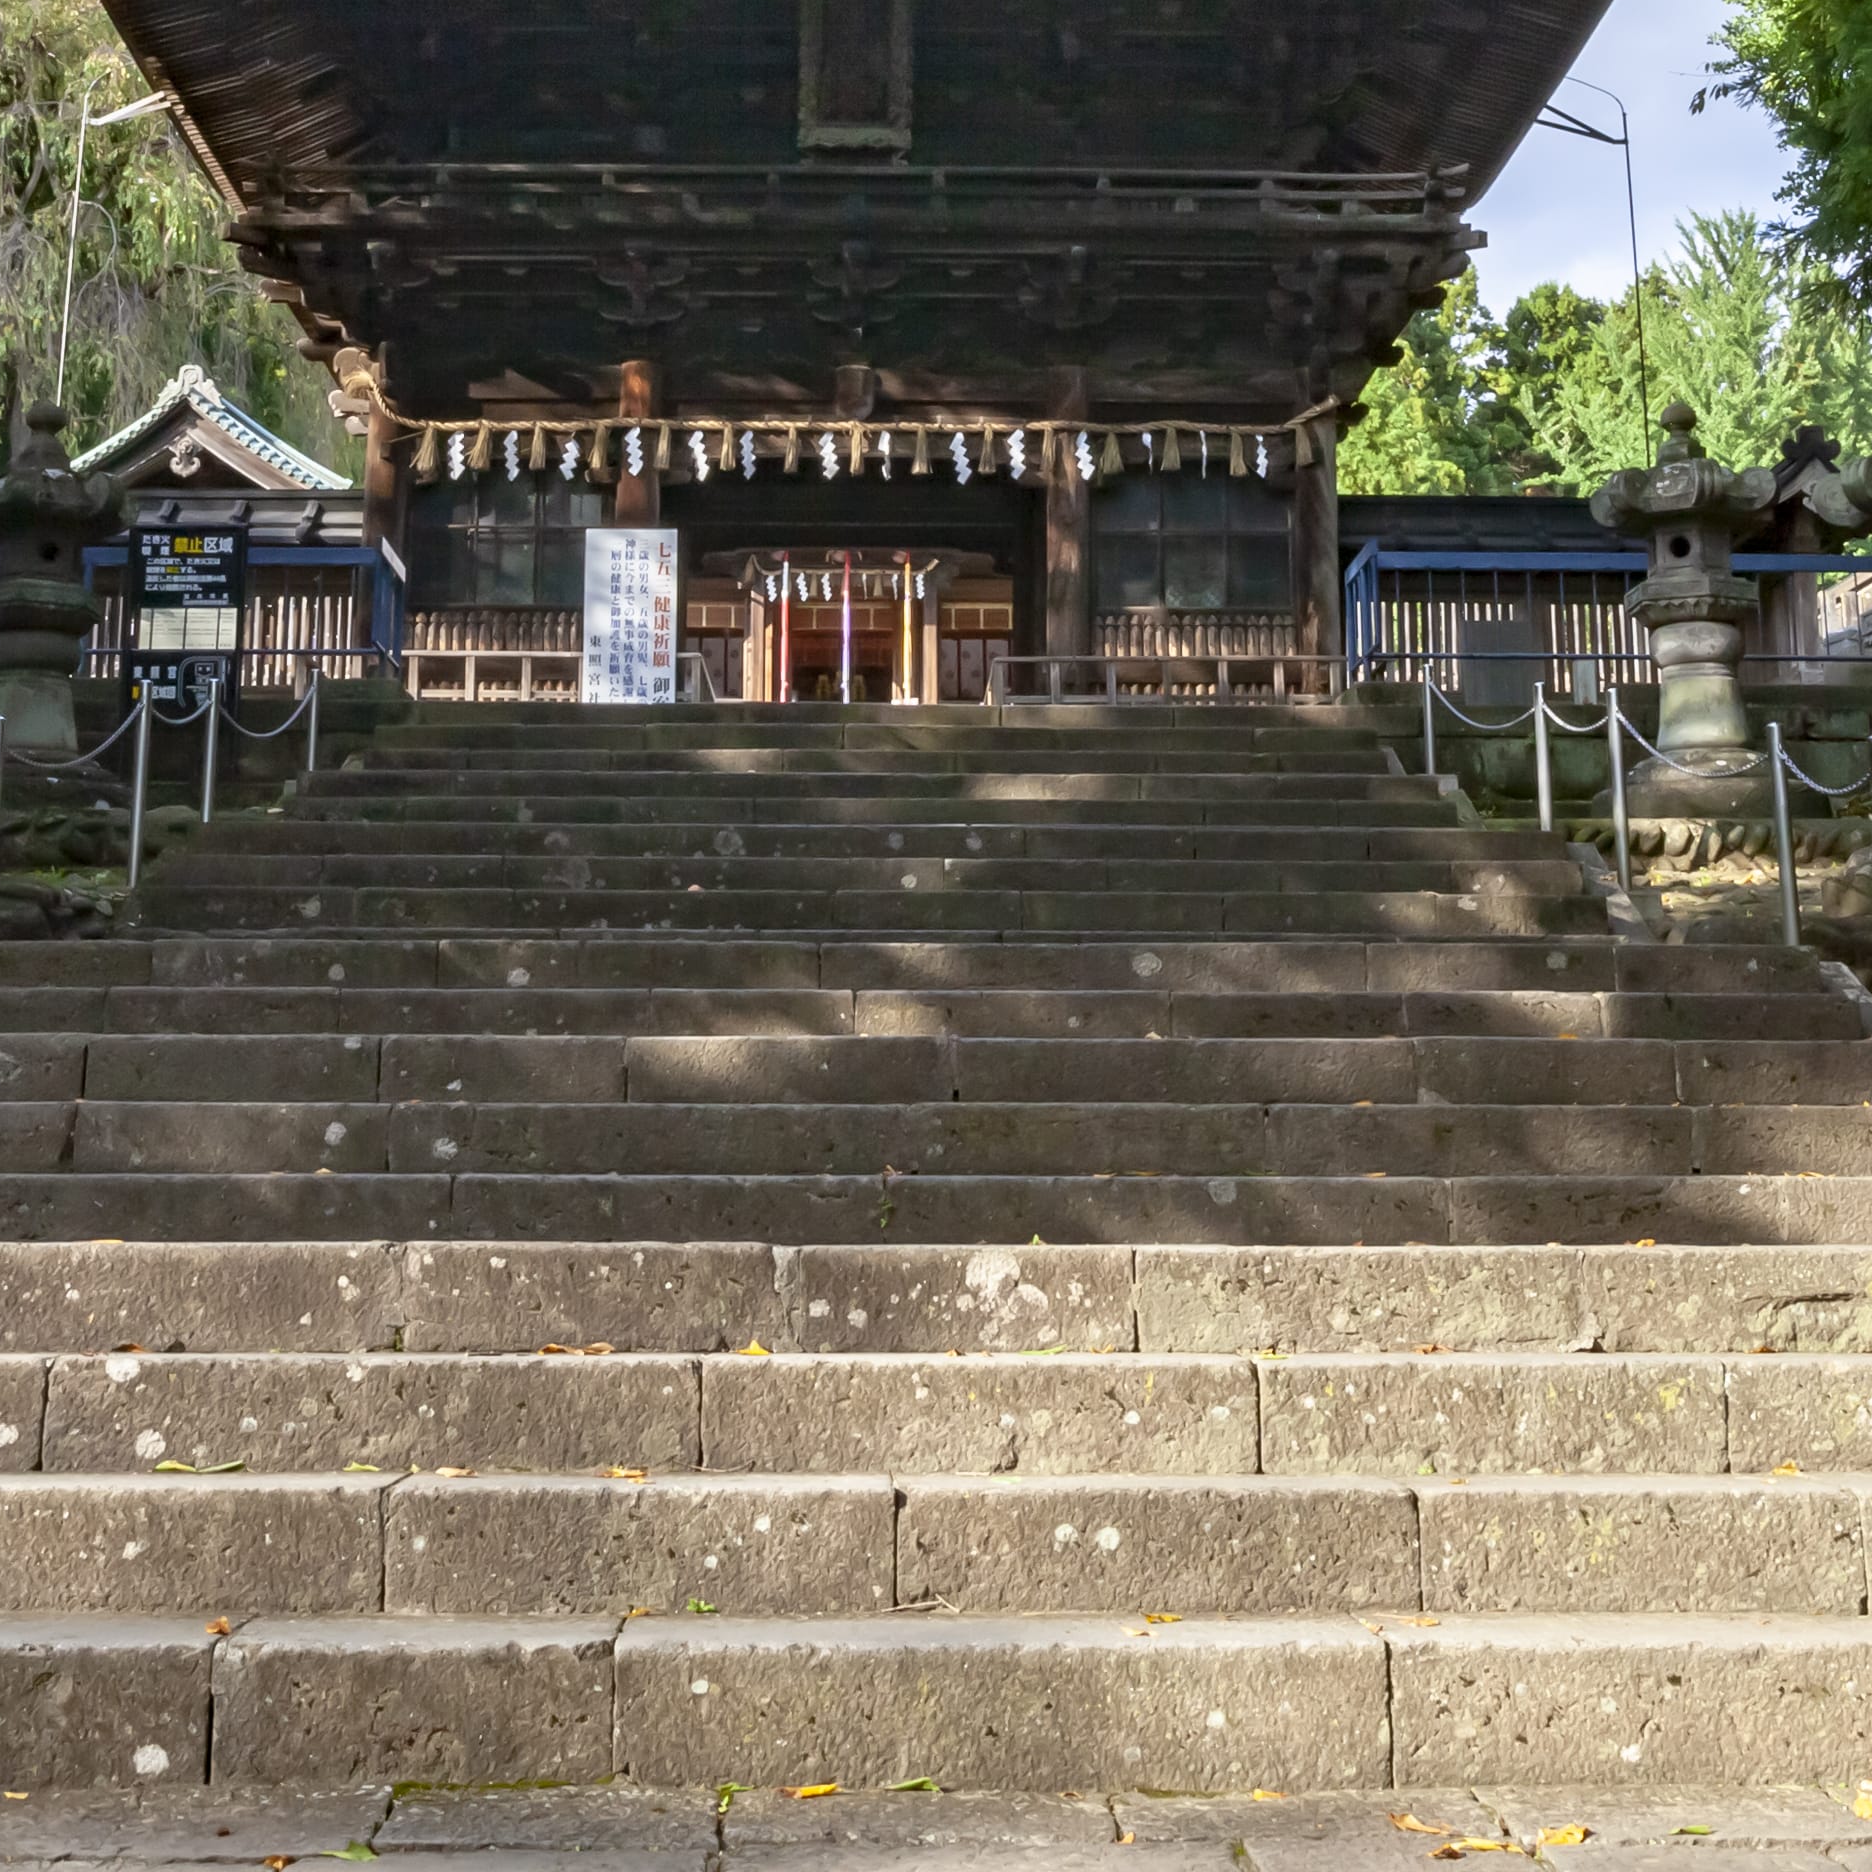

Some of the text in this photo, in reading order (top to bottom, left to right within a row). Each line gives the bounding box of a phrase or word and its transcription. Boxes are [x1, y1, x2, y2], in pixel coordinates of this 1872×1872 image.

[653, 542, 671, 667] 七五三健康祈願
